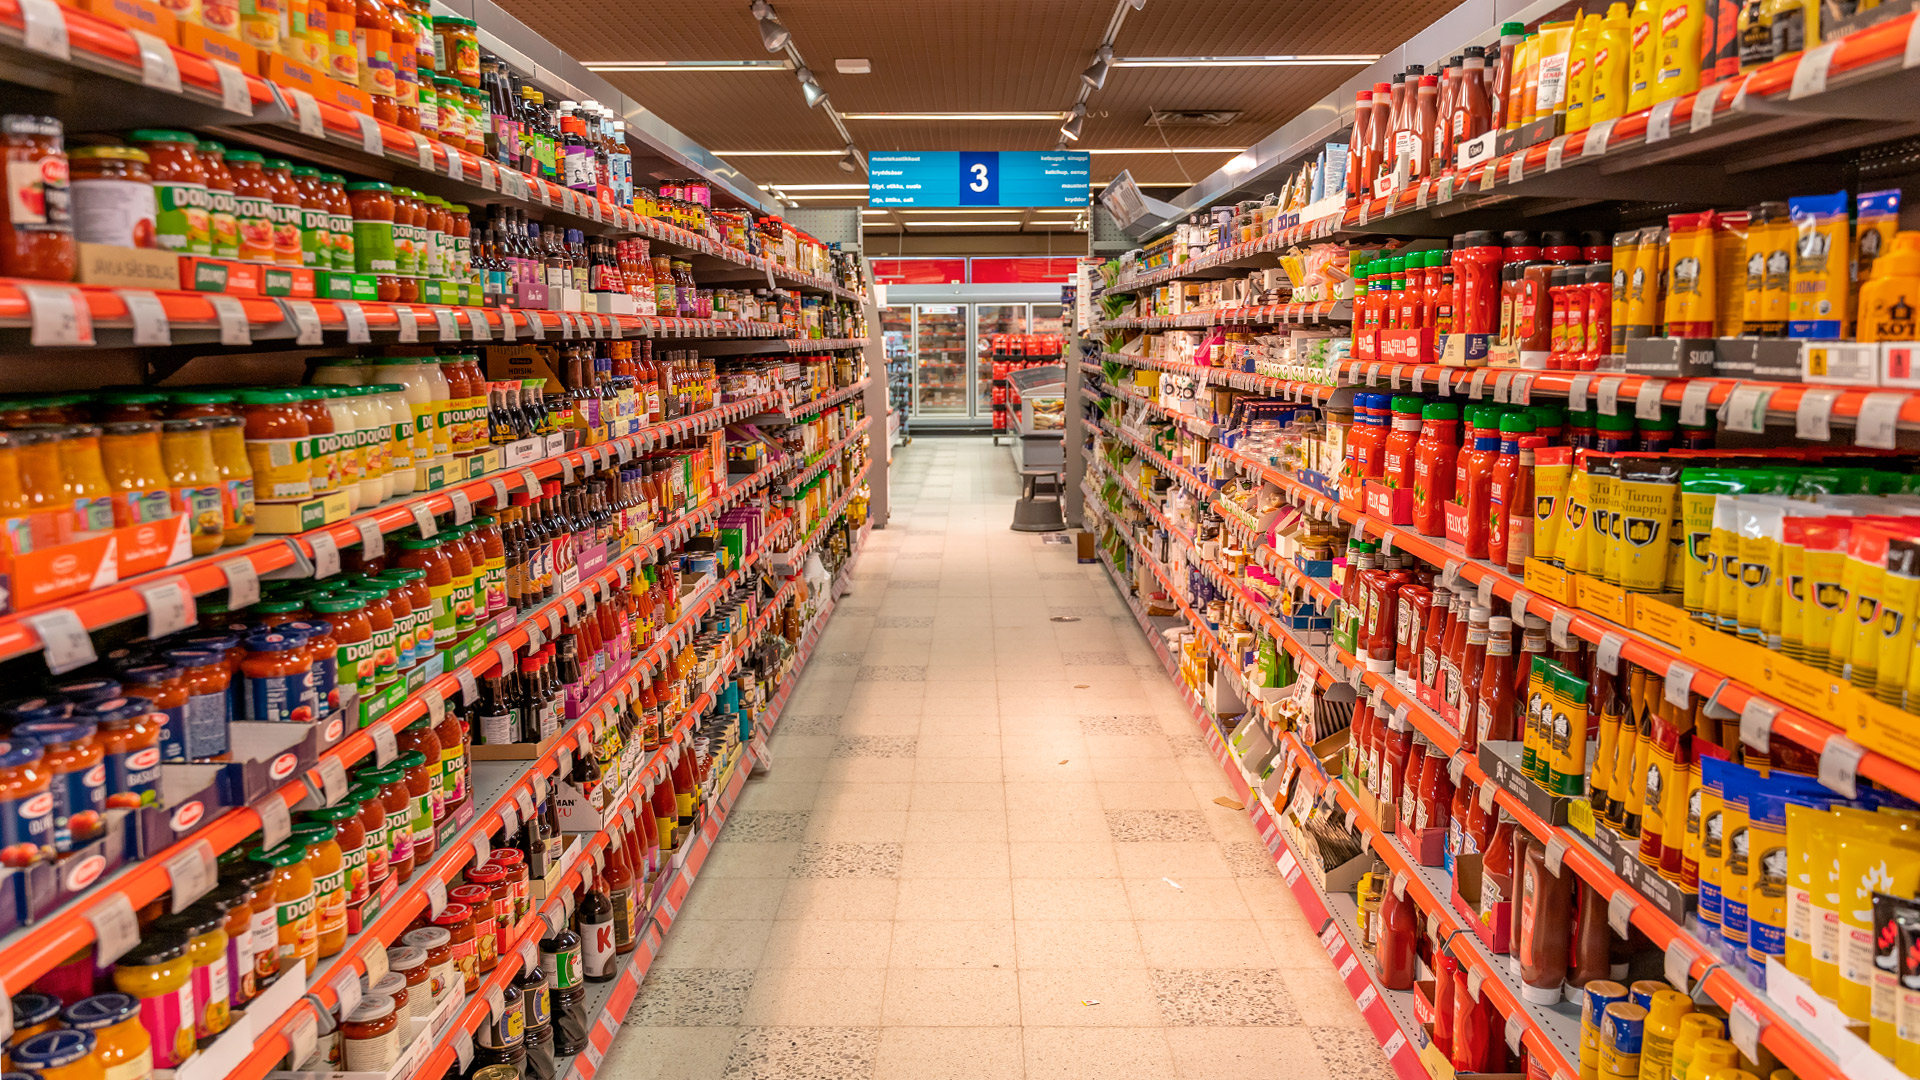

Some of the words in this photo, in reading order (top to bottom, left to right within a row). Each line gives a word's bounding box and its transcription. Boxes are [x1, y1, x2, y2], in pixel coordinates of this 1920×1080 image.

[969, 163, 989, 192] 3
[173, 188, 207, 208] DOL
[306, 213, 329, 228] DOL
[393, 226, 414, 238] DOLM
[357, 431, 379, 446] DOL
[1594, 482, 1610, 493] Tu
[1624, 488, 1663, 504] Turun
[1368, 491, 1379, 509] FELIX
[1620, 500, 1667, 517] Sinappia
[1689, 501, 1713, 515] Tur
[1446, 512, 1462, 534] FELIX
[1685, 514, 1712, 532] Sinap
[346, 641, 373, 661] DOL
[385, 809, 412, 829] DOLM
[558, 807, 572, 818] ZU
[367, 828, 388, 848] OLM
[343, 847, 367, 868] DOL
[314, 870, 345, 895] DOLM
[286, 895, 316, 921] DOL
[597, 925, 611, 954] K
